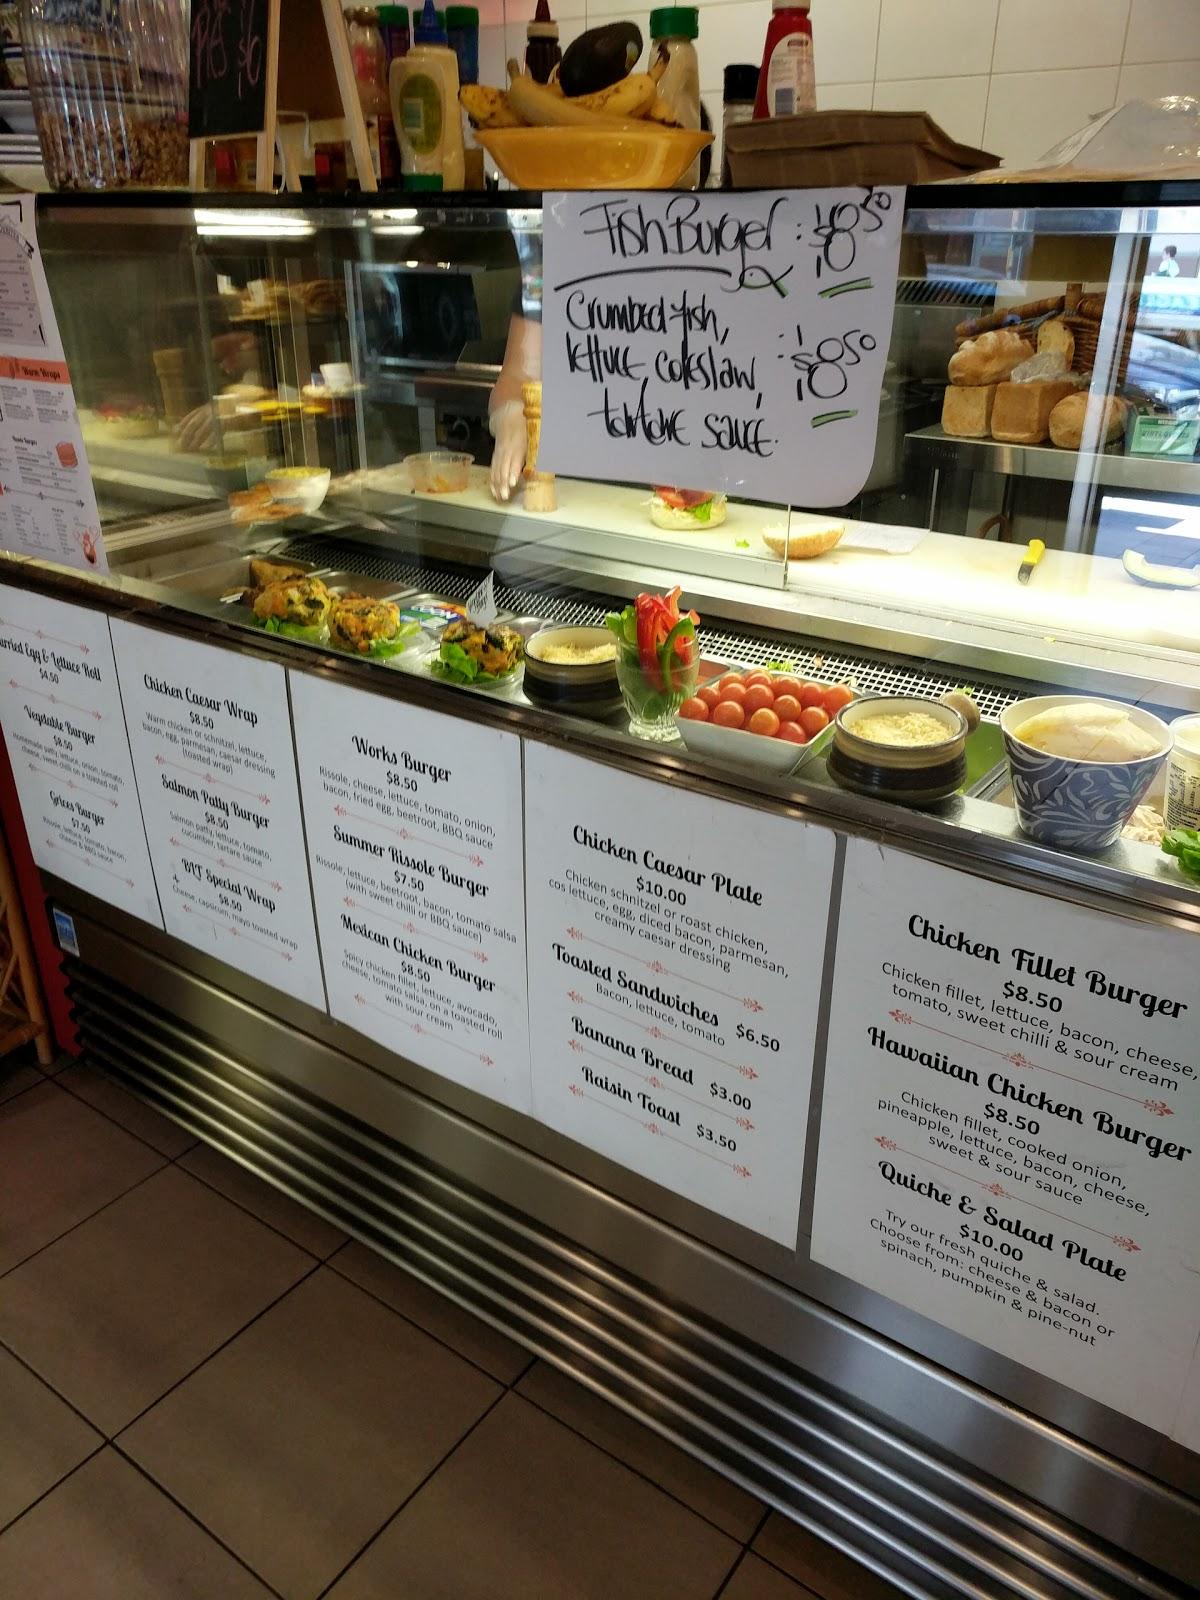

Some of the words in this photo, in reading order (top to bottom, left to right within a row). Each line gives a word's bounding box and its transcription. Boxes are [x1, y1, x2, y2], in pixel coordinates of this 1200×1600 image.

[580, 199, 668, 258] Fish
[666, 195, 789, 270] Burger
[566, 290, 668, 334] Crumbed
[669, 290, 728, 345] fish,
[143, 673, 183, 700] Chicken
[185, 687, 221, 711] Caesar
[223, 699, 257, 726] Wrap
[189, 710, 213, 729] $8.50
[351, 735, 397, 765] Works
[400, 751, 451, 783] Burger
[386, 770, 417, 792] $8.50
[161, 773, 199, 801] Salmon
[200, 789, 229, 817] Patty
[230, 801, 269, 829] Burger
[204, 811, 228, 830] $8.50
[205, 868, 241, 896] Special
[243, 885, 275, 913] Wrap
[333, 824, 385, 857] Summer
[388, 846, 434, 877] Rissole
[438, 864, 488, 897] Burger
[394, 869, 424, 891] $7.50
[573, 824, 637, 864] Chicken
[643, 850, 706, 886] Caesar
[711, 872, 762, 906] Plate
[636, 875, 686, 905] $10.00
[218, 893, 242, 912] $8.50
[548, 878, 565, 892] cos
[569, 883, 608, 910] lettuce,
[612, 903, 635, 921] egg,
[639, 912, 670, 933] diced
[674, 923, 714, 951] bacon,
[719, 943, 788, 978] parmesan,
[565, 869, 606, 894] Chicken
[610, 887, 659, 914] schnitzel
[663, 908, 676, 919] or
[680, 914, 711, 932] roast
[715, 925, 767, 954] chicken,
[340, 913, 389, 948] Mexican
[393, 936, 442, 971] Chicken
[446, 959, 495, 991] Burger
[401, 960, 430, 982] $8.50
[594, 911, 635, 935] creamy
[638, 928, 675, 949] caesar
[679, 942, 730, 973] dressing
[908, 914, 1000, 964] Chicken
[1011, 948, 1076, 986] Fillet
[1084, 970, 1187, 1018] Burger
[551, 942, 612, 982] Toasted
[616, 969, 718, 1026] Sandwiches
[735, 1023, 779, 1051] $6.50
[596, 982, 631, 1008] Bacon,
[635, 999, 677, 1028] lettuce,
[681, 1019, 724, 1046] tomato
[882, 961, 939, 992] Chicken
[945, 984, 984, 1010] fillet,
[991, 999, 1053, 1033] lettuce,
[1060, 1022, 1118, 1055] bacon,
[1126, 1046, 1199, 1081] cheese,
[1002, 979, 1062, 1012] $8.50
[571, 1016, 636, 1059] Banana
[640, 1047, 693, 1085] Bread
[709, 1081, 751, 1110] $3.00
[892, 983, 951, 1016] tomato,
[956, 1009, 1005, 1033] sweet
[1010, 1026, 1049, 1048] chilli
[1054, 1039, 1067, 1055] &
[1073, 1049, 1114, 1068] sour
[1119, 1064, 1177, 1091] cream
[581, 1065, 632, 1103] Raisin
[637, 1092, 680, 1126] Toast
[696, 1123, 736, 1151] $3.50
[867, 1026, 979, 1086] Hawaiian
[987, 1072, 1083, 1124] Chicken
[1092, 1110, 1192, 1161] Burger
[983, 1102, 1039, 1135] $8.50
[878, 1099, 953, 1138] pineapple,
[959, 1129, 1016, 1164] lettuce,
[1023, 1154, 1077, 1188] bacon,
[1083, 1182, 1149, 1216] cheese,
[901, 1091, 958, 1123] Chicken
[963, 1115, 1001, 1142] fillet,
[1007, 1136, 1067, 1165] cooked
[1072, 1161, 1125, 1190] onion,
[928, 1136, 973, 1161] sweet
[978, 1154, 990, 1168] &
[995, 1163, 1031, 1183] sour
[1035, 1179, 1082, 1204] sauce
[878, 1160, 951, 1206] Quiche
[958, 1195, 976, 1214] &
[983, 1206, 1053, 1251] Salad
[1061, 1239, 1126, 1281] Plate
[959, 1223, 1023, 1261] $10.00
[870, 1218, 920, 1248] Choose
[925, 1242, 963, 1269] from:
[968, 1265, 1020, 1295] cheese
[1025, 1289, 1037, 1303] &
[1043, 1296, 1090, 1327] bacon
[1096, 1324, 1115, 1336] or
[880, 1239, 936, 1272] spinach,
[941, 1268, 1005, 1304] pumpkin
[1010, 1298, 1022, 1312] &
[1027, 1308, 1095, 1346] pine-nut
[885, 1209, 906, 1227] Try
[910, 1223, 934, 1239] our
[939, 1233, 974, 1259] fresh
[980, 1255, 1030, 1283] quiche
[1035, 1278, 1047, 1292] &
[1053, 1288, 1099, 1315] salad.
